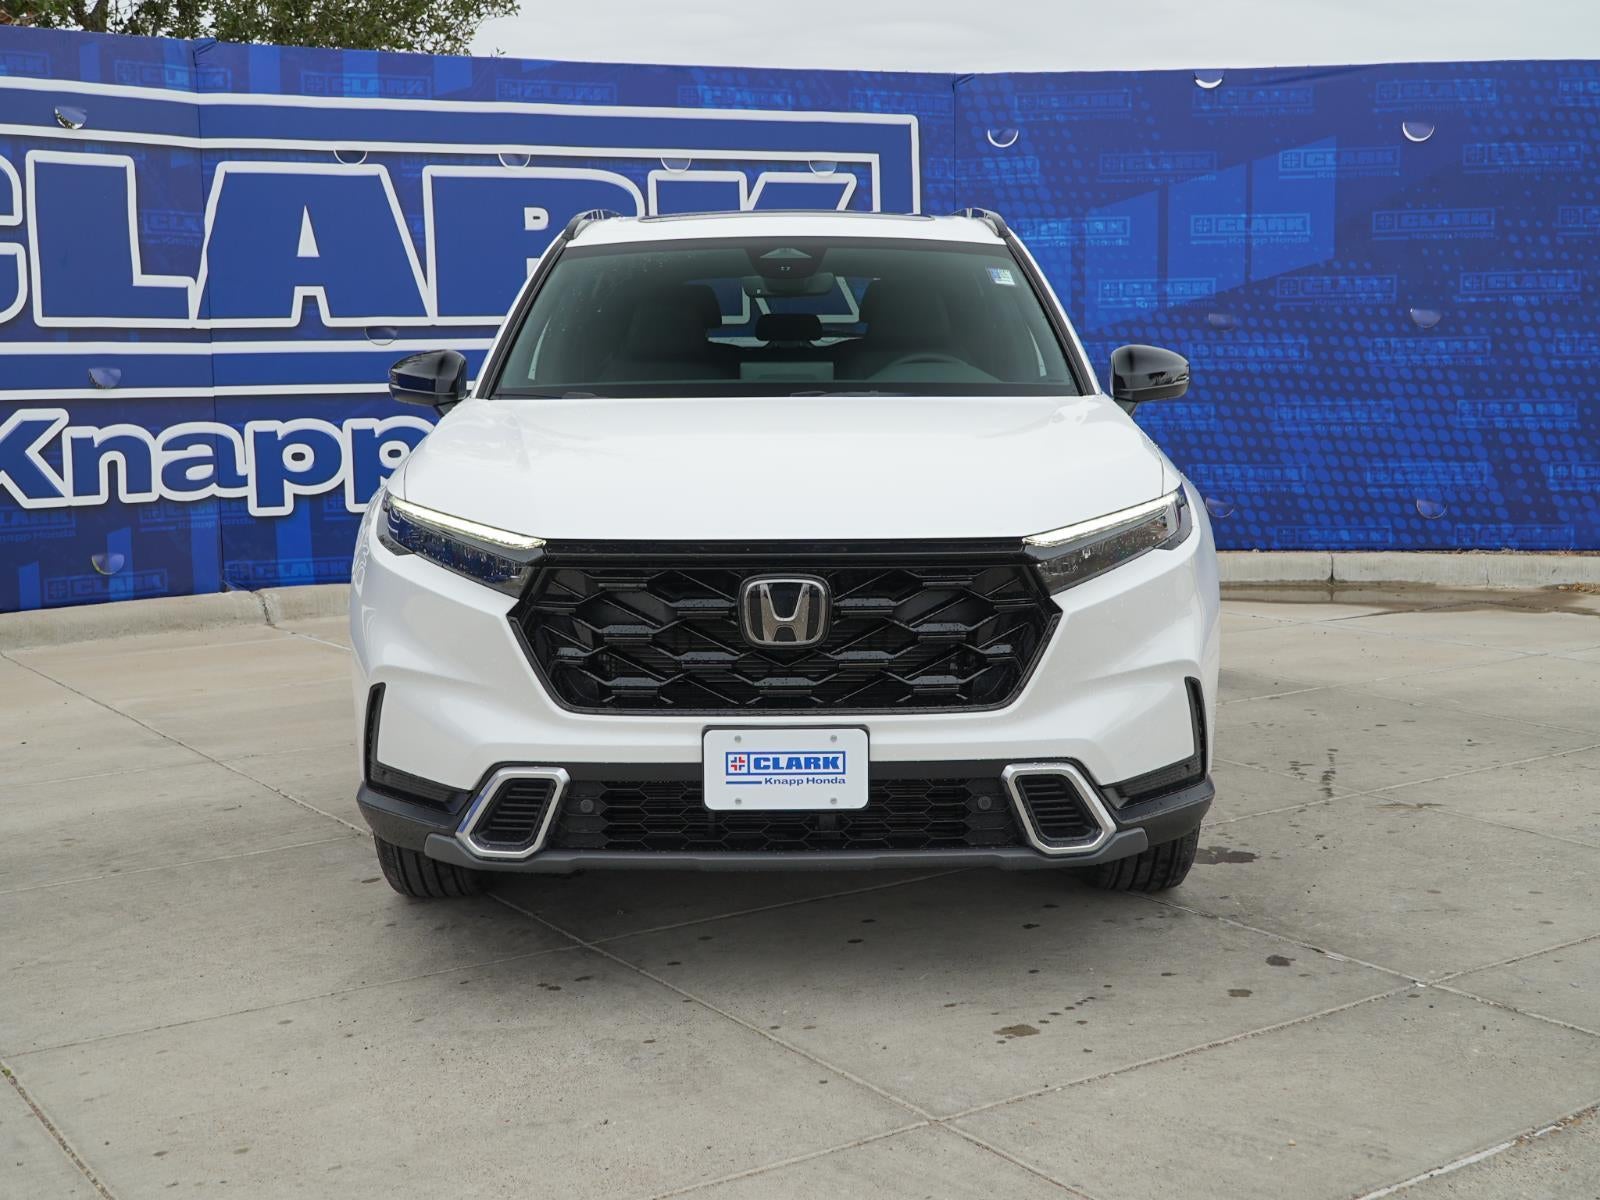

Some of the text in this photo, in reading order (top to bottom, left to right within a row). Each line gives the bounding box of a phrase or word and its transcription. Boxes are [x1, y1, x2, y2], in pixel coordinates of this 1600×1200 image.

[1217, 215, 1306, 233] CLARK
[1270, 234, 1310, 244] Honda
[753, 756, 840, 771] CLARK
[764, 776, 846, 786] Knapp Honda
